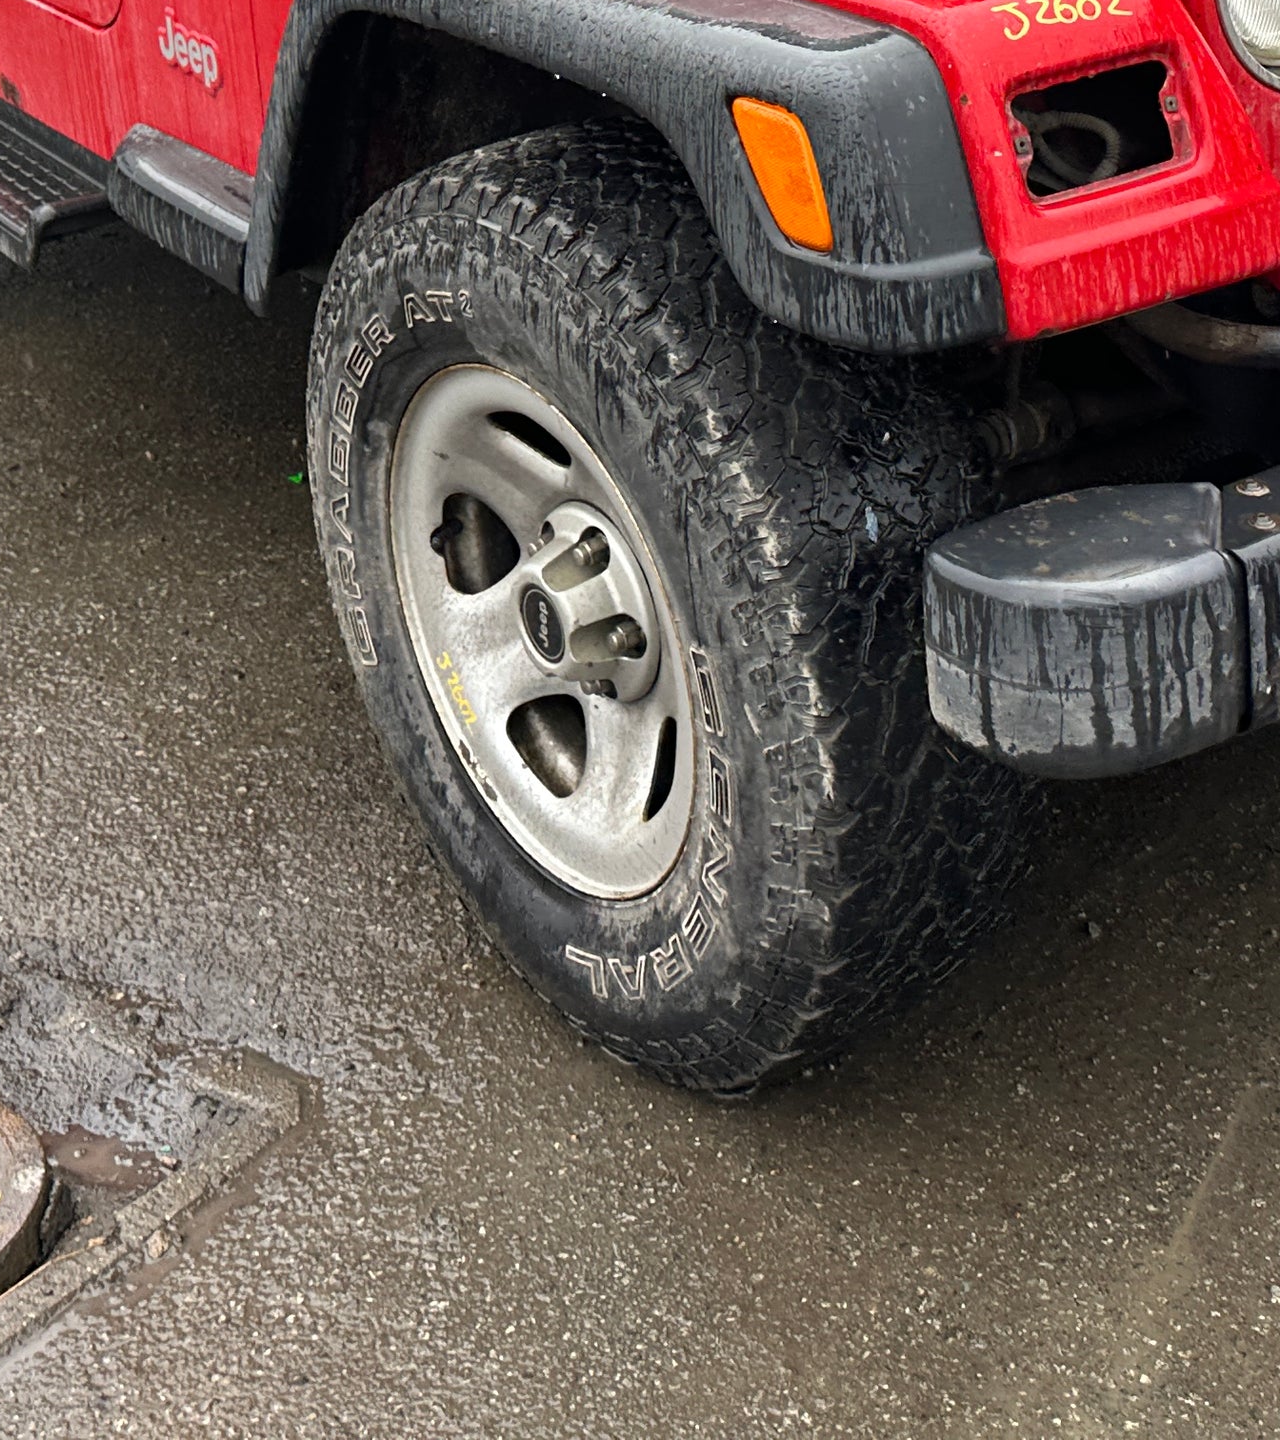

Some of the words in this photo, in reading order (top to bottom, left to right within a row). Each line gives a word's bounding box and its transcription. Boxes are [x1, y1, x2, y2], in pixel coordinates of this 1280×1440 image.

[158, 15, 219, 88] Jeep
[329, 313, 395, 667] GRABBER
[538, 601, 549, 648] Jeep
[565, 645, 734, 1000] GENERAL
